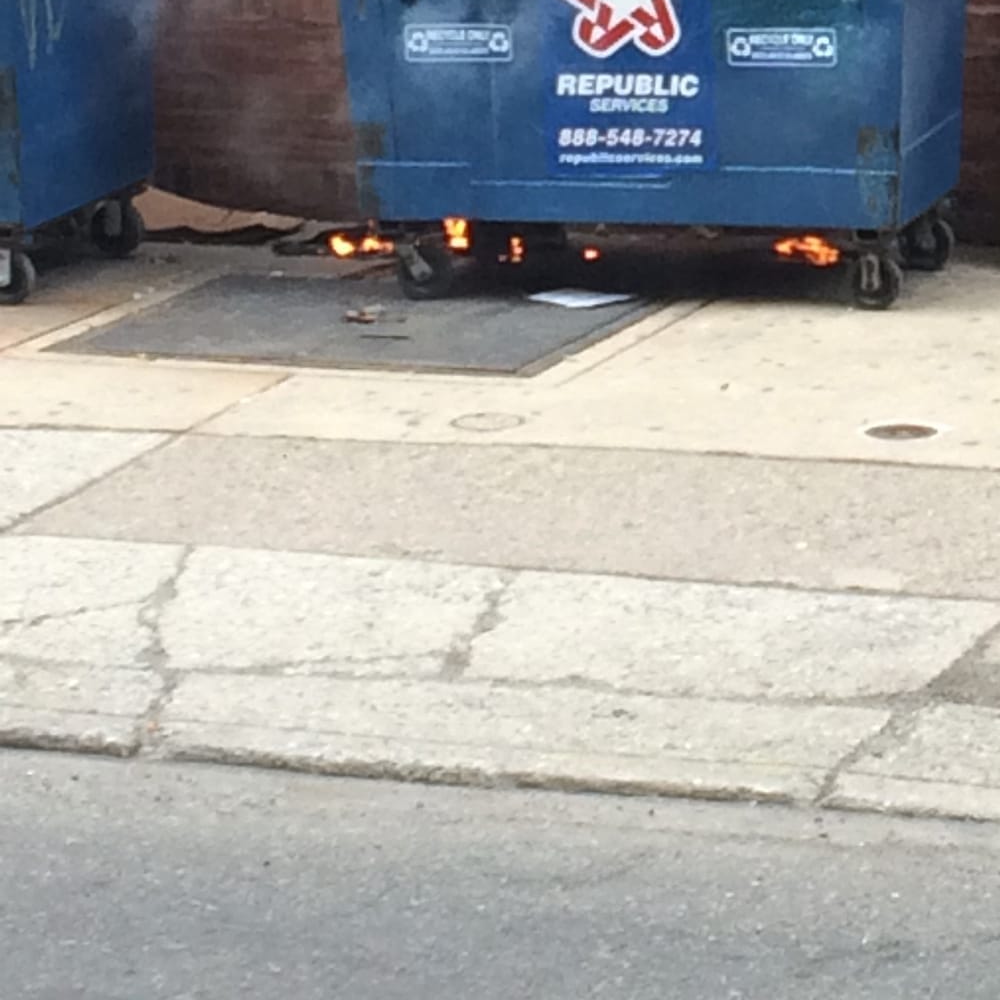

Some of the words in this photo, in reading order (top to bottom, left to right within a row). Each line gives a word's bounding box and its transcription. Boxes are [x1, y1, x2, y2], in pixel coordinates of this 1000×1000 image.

[556, 73, 700, 97] REPUBLIC
[589, 98, 669, 113] SERVICES
[558, 128, 702, 147] 888-548-7274
[558, 152, 704, 166] republicservices.com
